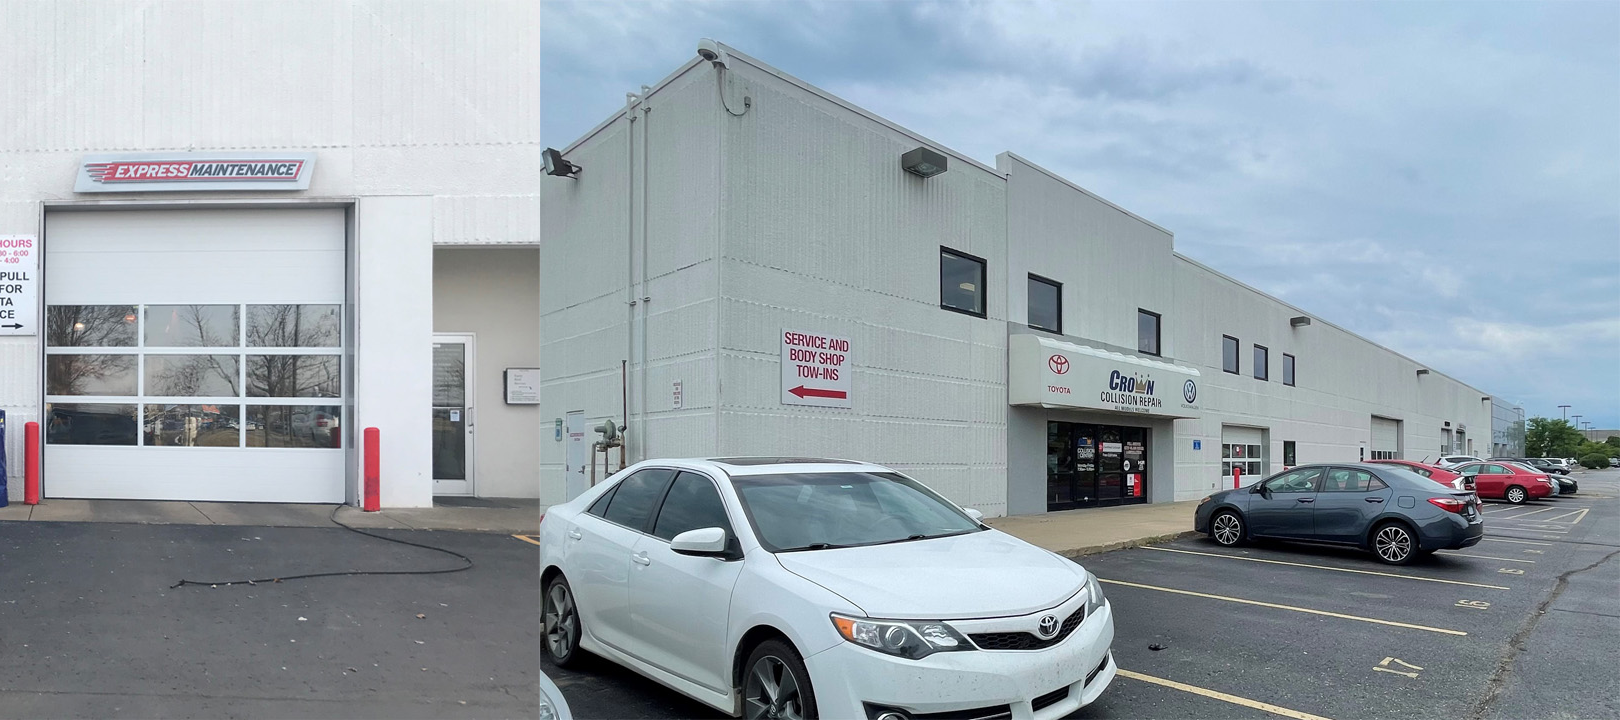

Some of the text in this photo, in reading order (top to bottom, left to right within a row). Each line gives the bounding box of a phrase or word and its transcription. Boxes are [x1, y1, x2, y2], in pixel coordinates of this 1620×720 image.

[115, 163, 297, 178] EXPRESS MAINTENANCE
[0, 271, 30, 281] PULL
[784, 331, 849, 353] SERVICE AND
[790, 347, 845, 366] BODY SHOP
[796, 364, 839, 381] TOW-INS
[1047, 385, 1071, 395] TOYOTA
[1100, 391, 1162, 408] COLLISION REPAIR
